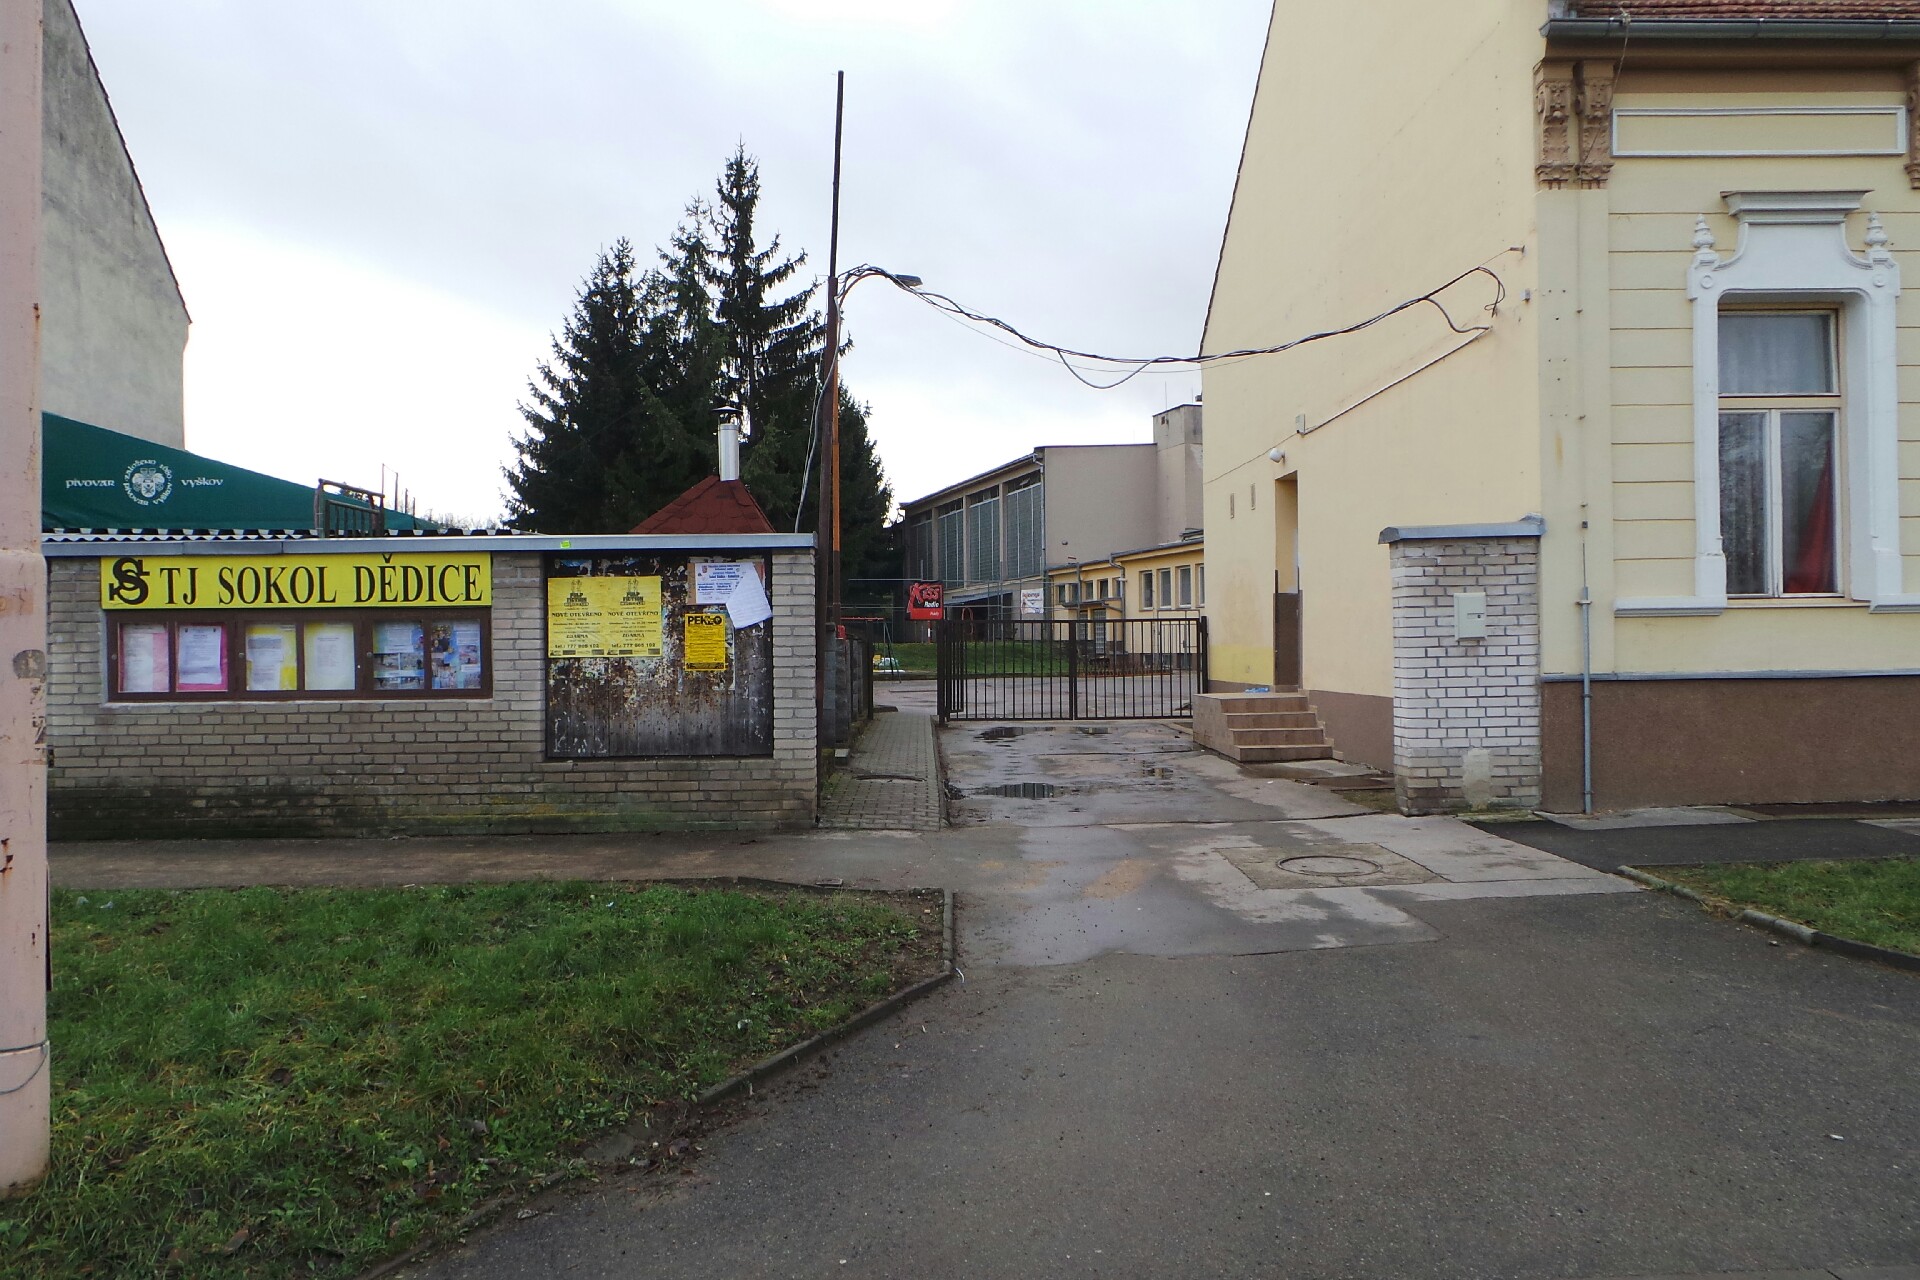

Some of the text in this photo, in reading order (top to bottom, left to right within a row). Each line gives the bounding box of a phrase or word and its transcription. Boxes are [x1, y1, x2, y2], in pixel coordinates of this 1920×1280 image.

[180, 477, 224, 488] vyškov
[160, 567, 199, 605] TJ
[218, 566, 337, 604] SOKOL
[353, 553, 483, 604] DĚDICE
